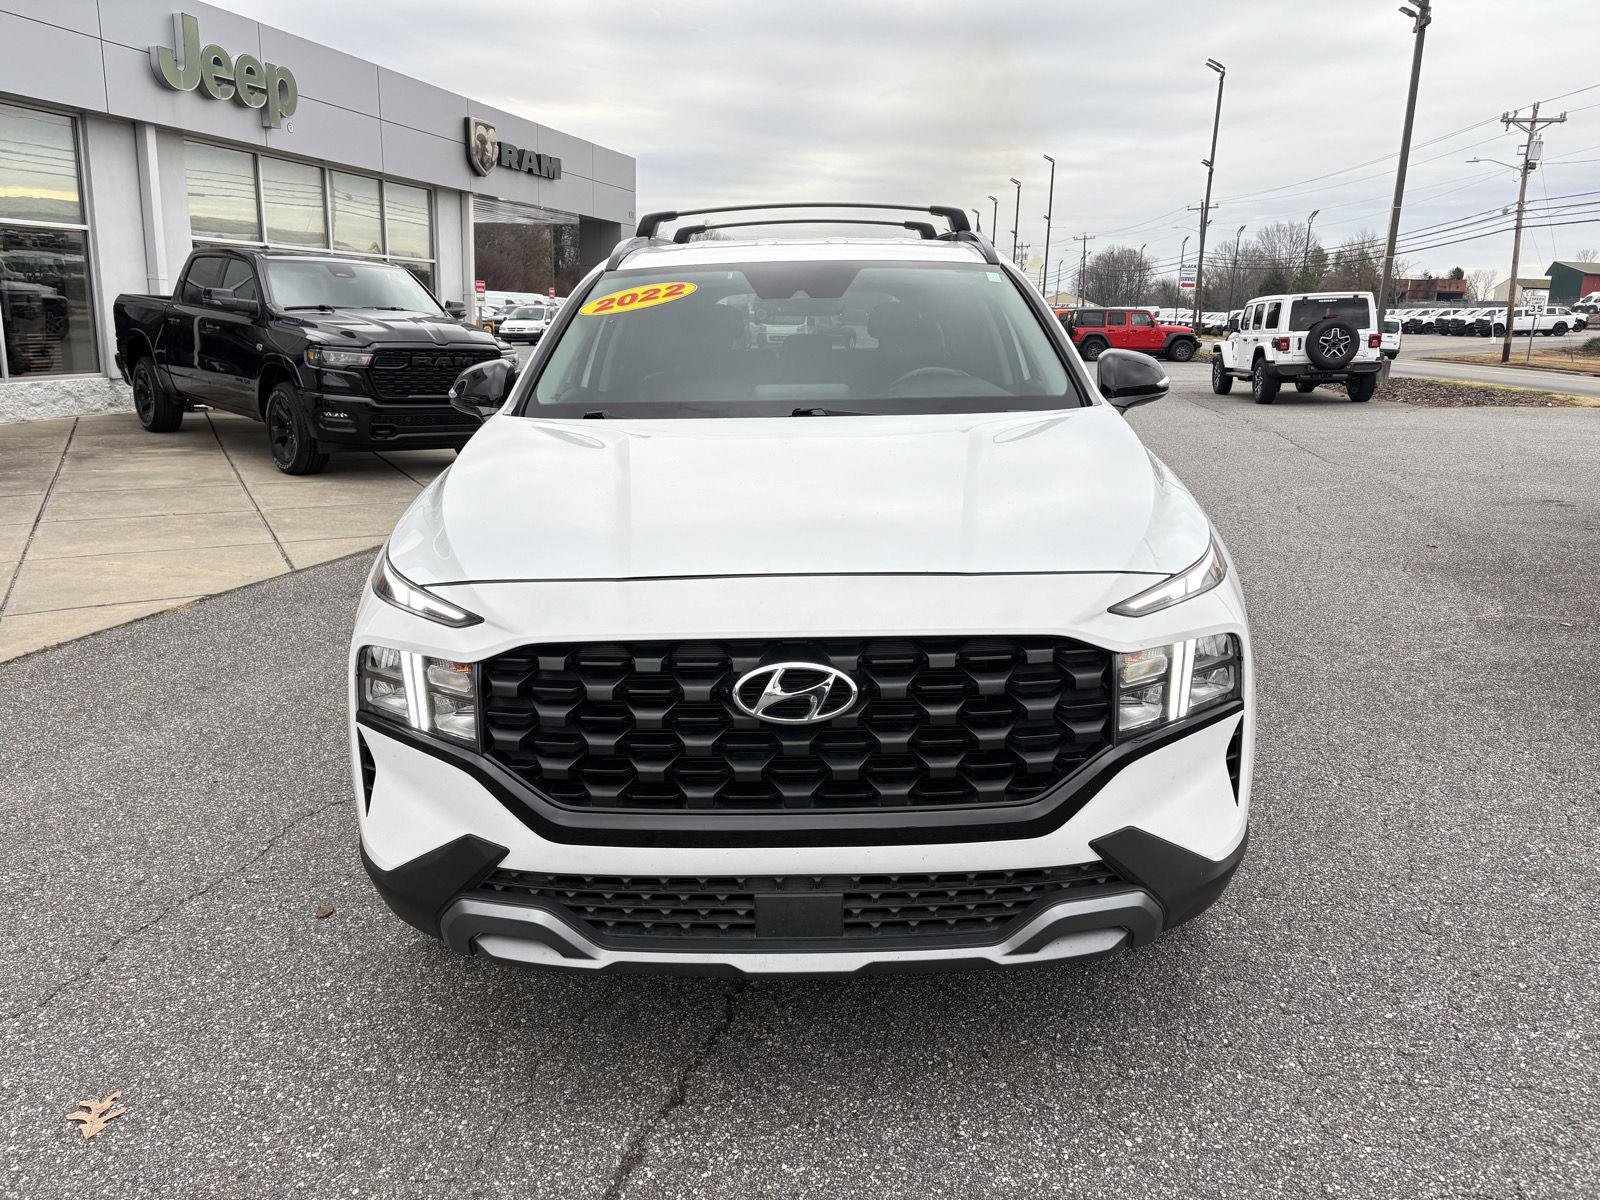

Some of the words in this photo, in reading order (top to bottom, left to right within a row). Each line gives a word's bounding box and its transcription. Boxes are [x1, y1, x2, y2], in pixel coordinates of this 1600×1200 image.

[148, 12, 298, 129] Jeep
[497, 142, 561, 180] RAM
[592, 283, 686, 313] 2022
[411, 356, 475, 367] RAM
